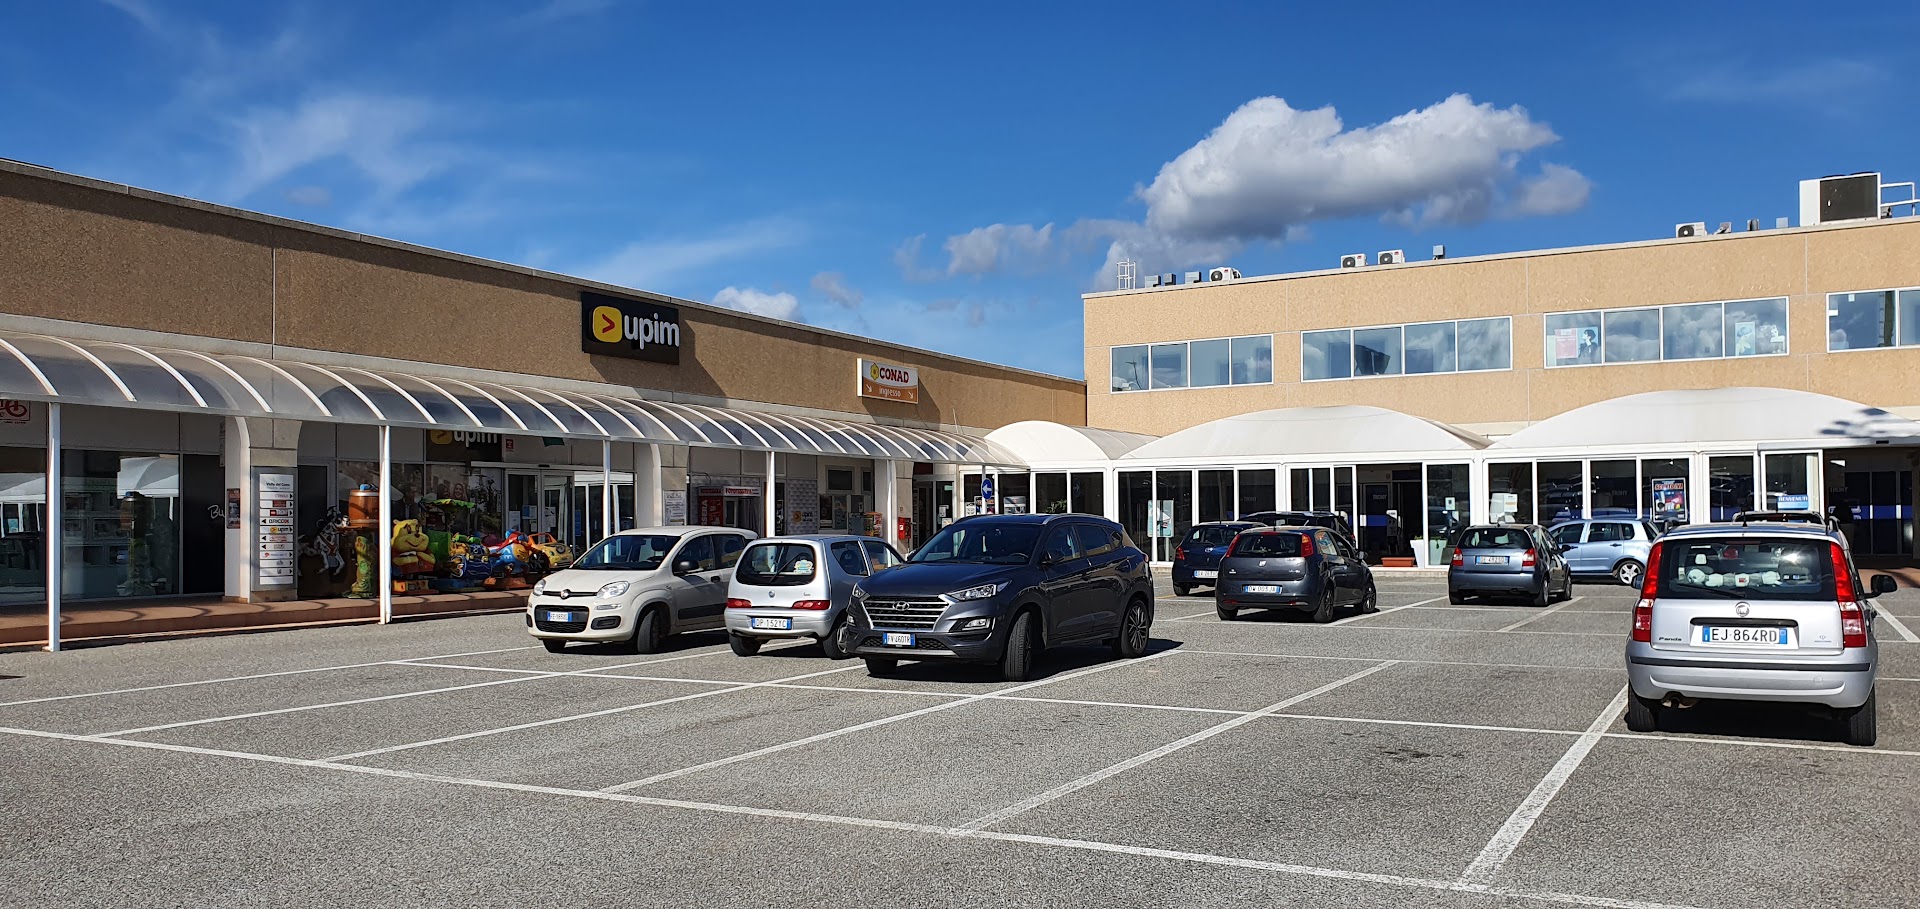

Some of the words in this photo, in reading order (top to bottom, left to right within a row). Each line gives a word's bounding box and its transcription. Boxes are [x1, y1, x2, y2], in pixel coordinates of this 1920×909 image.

[624, 312, 680, 350] upim
[880, 367, 910, 383] CONAD
[879, 386, 902, 397] ingresso
[1711, 628, 1729, 641] EJ
[1733, 628, 1777, 643] 864RD
